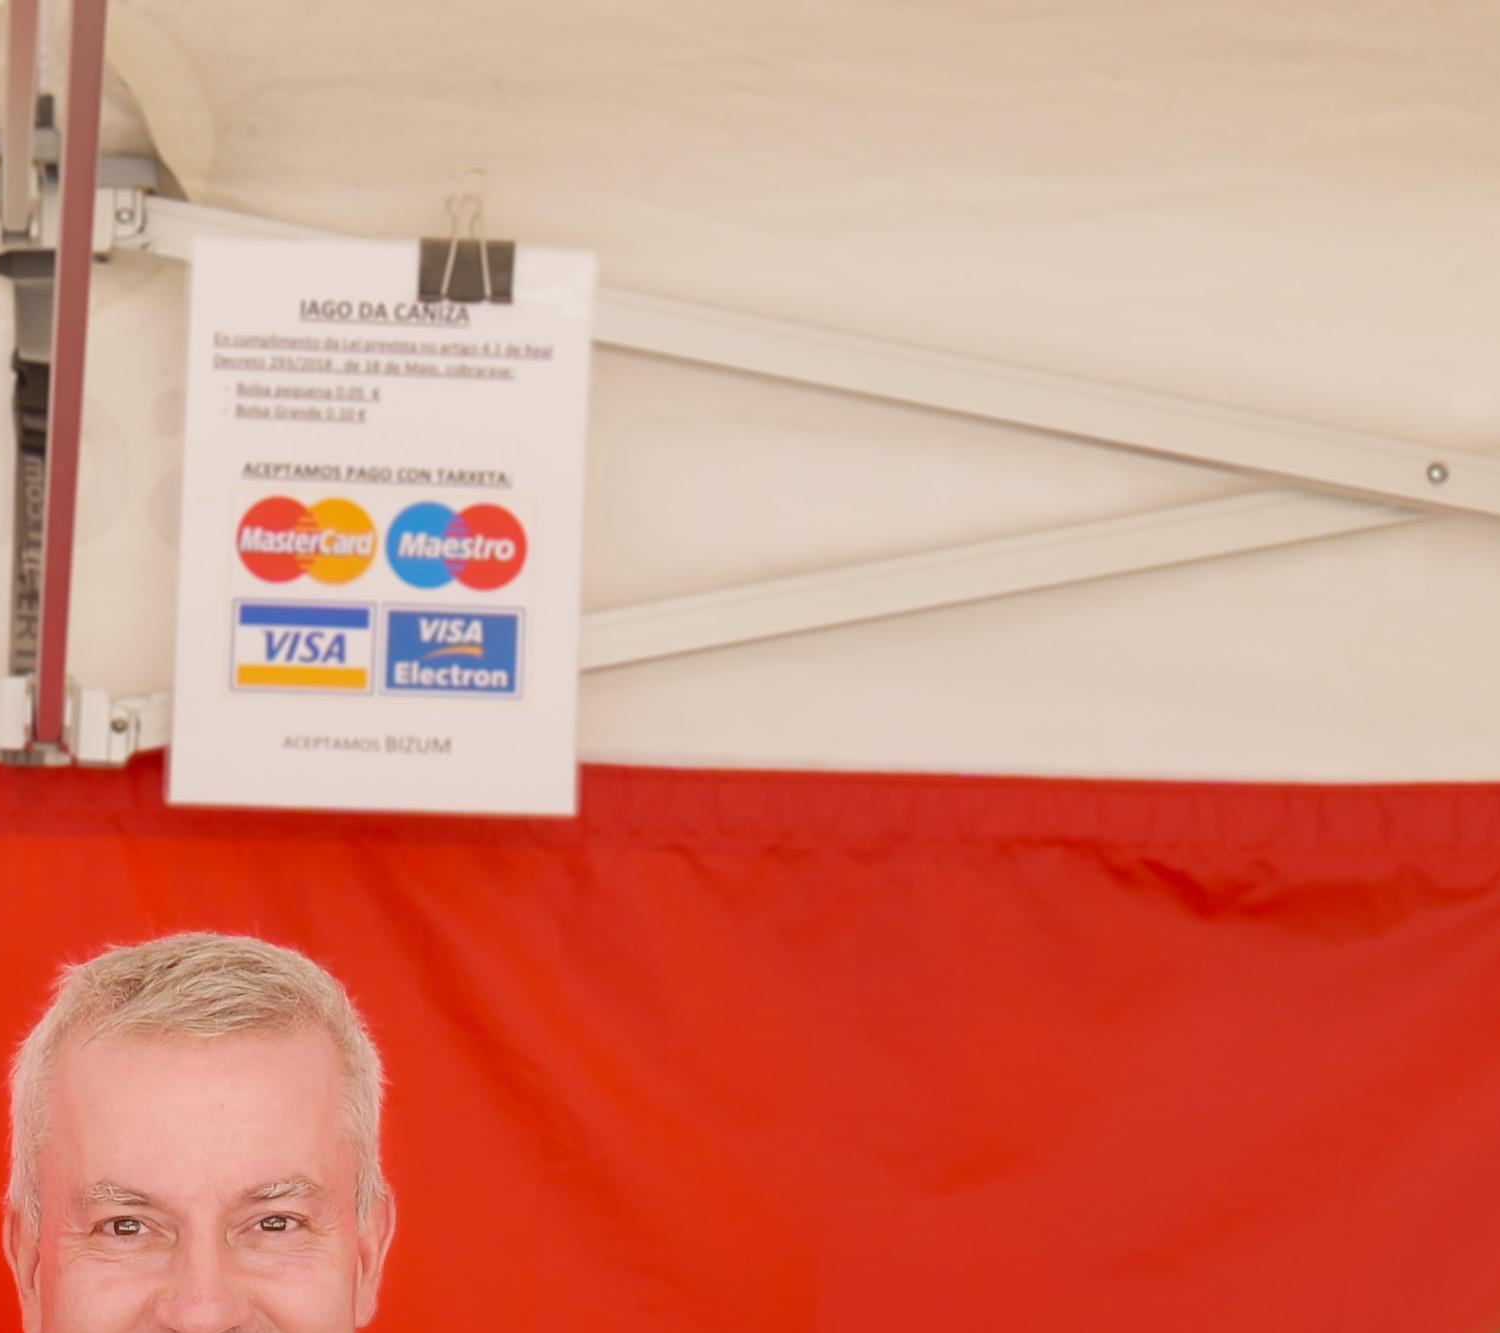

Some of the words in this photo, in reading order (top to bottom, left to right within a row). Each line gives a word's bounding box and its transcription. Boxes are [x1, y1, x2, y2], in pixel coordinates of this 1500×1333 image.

[359, 302, 388, 322] DA
[243, 462, 342, 482] ACEPTAMOS
[347, 466, 392, 483] PAGO
[396, 467, 433, 485] CON
[239, 523, 373, 558] MasterCard
[397, 529, 516, 564] Maestro
[417, 616, 485, 646] VISA
[263, 629, 347, 665] VISA
[392, 660, 510, 690] Electron
[282, 734, 380, 754] ACEPTAMOS
[384, 734, 453, 757] BIZUM
